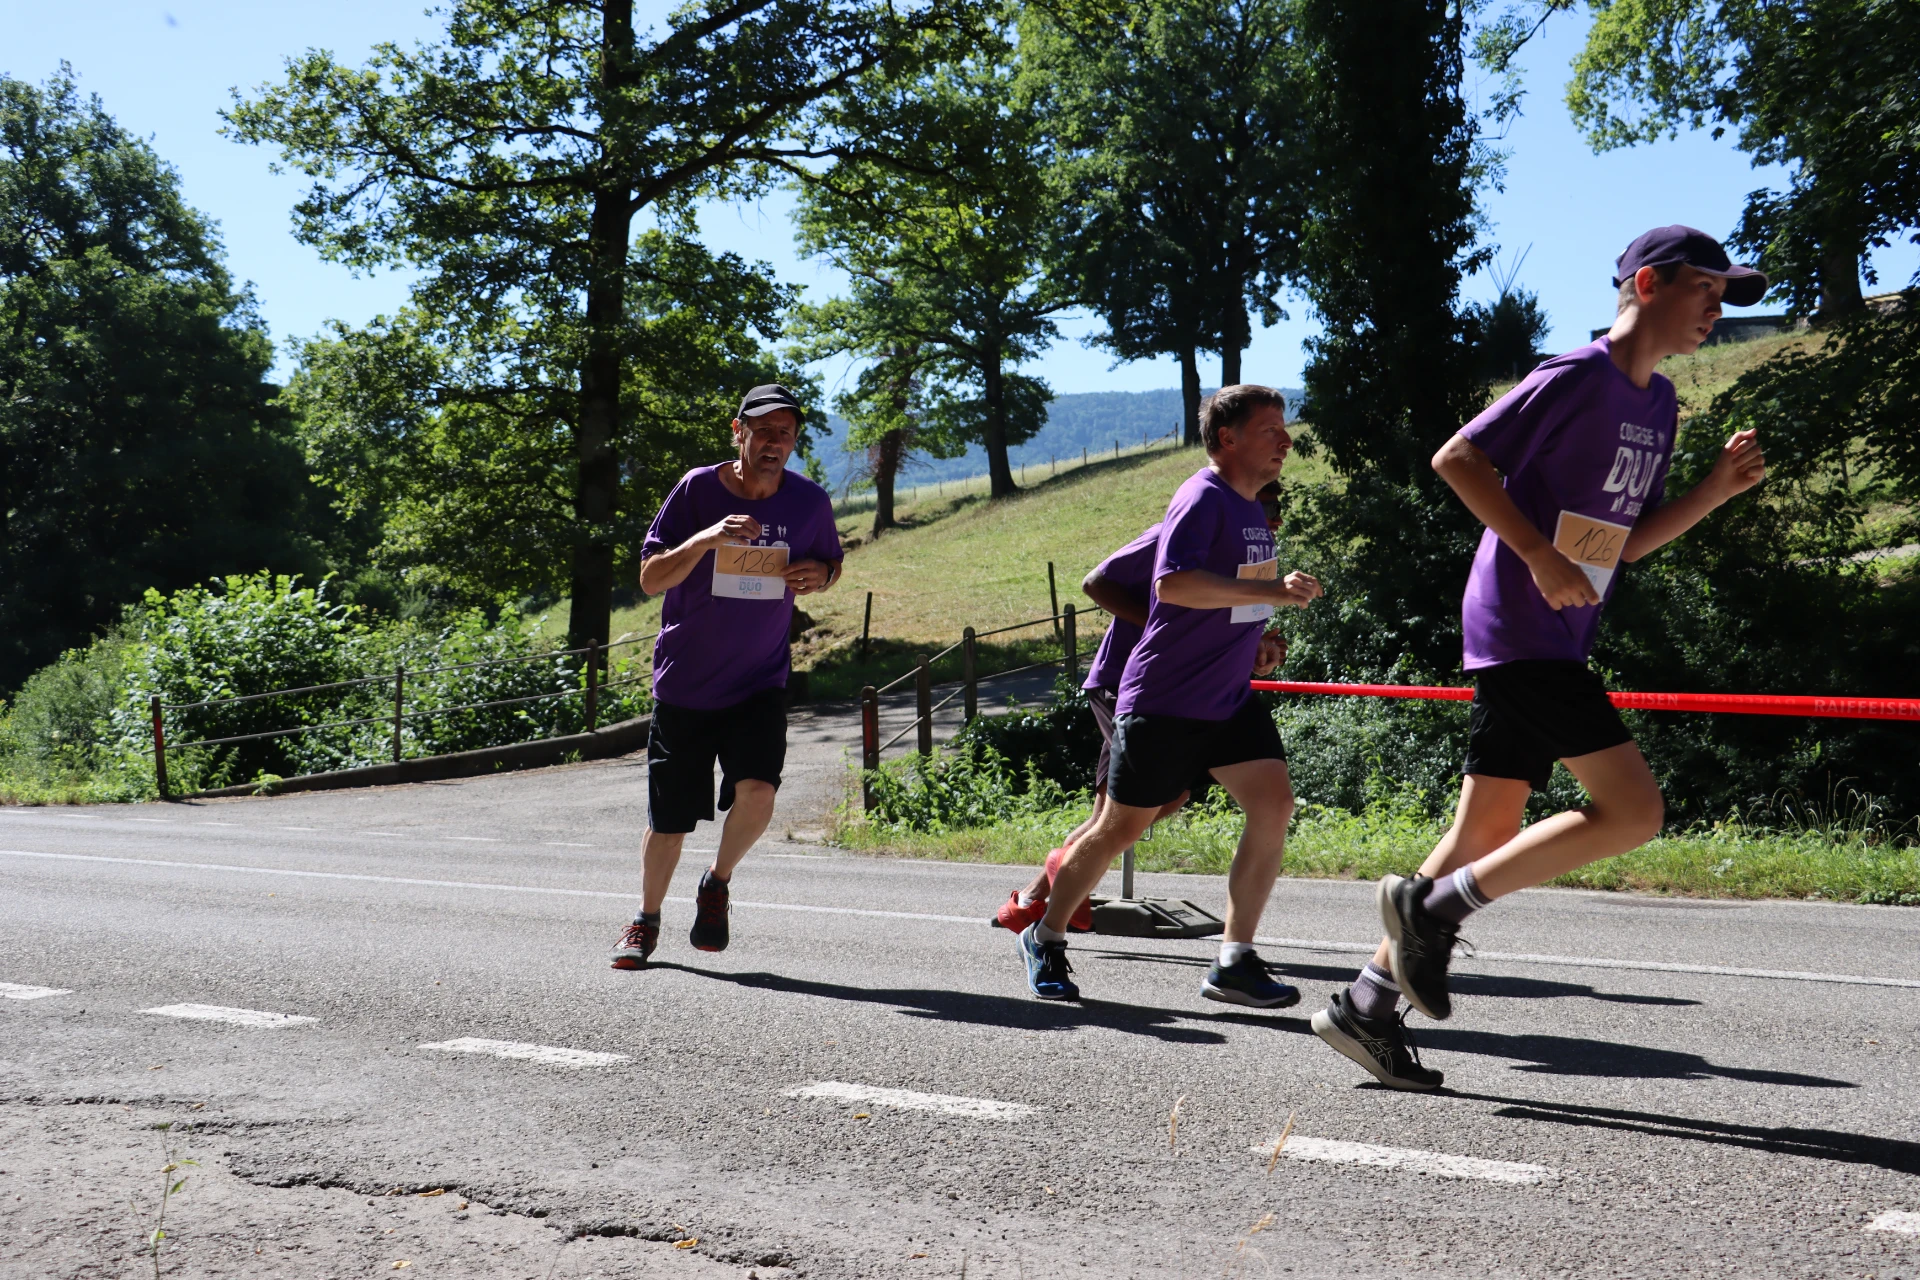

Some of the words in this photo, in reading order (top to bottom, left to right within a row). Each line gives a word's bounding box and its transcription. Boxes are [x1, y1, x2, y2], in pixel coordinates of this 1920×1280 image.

[1574, 527, 1619, 562] 126
[733, 549, 776, 574] 126
[739, 581, 762, 591] DUO
[1611, 692, 1679, 706] FFEISEN
[1814, 699, 1920, 716] RAIFFEISEN
